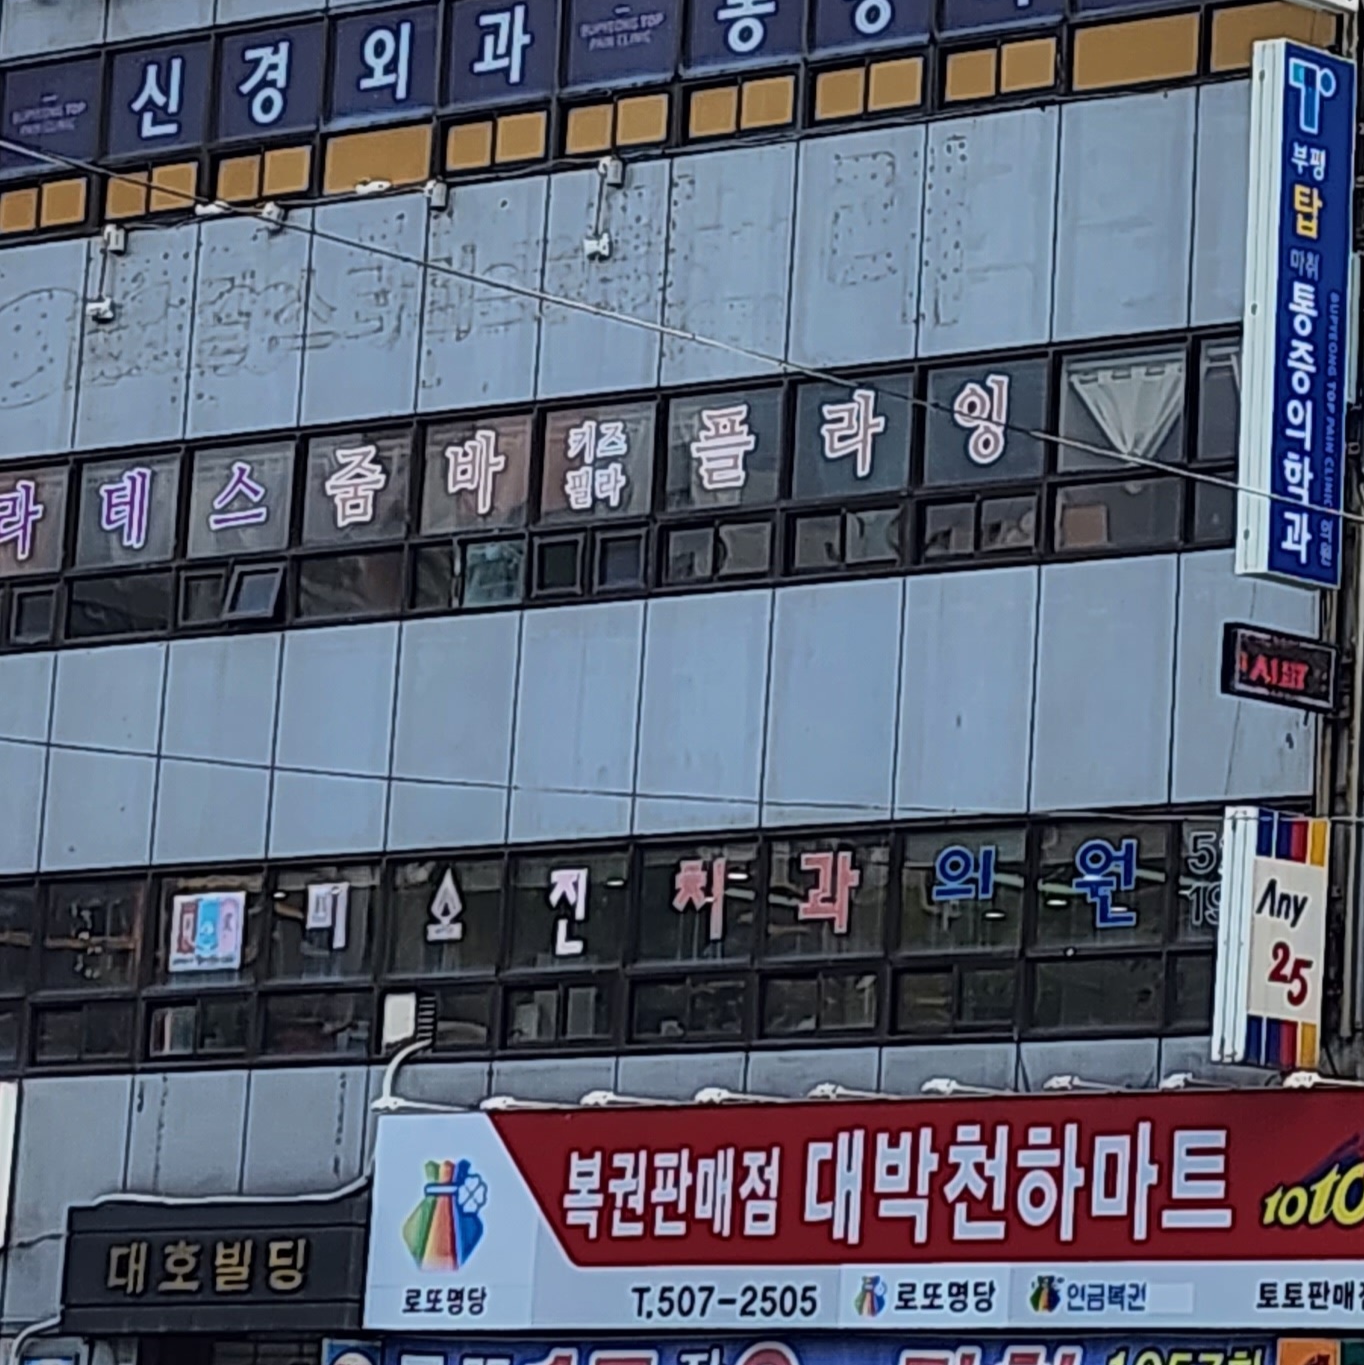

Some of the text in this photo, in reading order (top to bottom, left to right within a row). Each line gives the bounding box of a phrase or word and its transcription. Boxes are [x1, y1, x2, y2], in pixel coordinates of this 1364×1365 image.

[130, 3, 532, 139] 신경외과
[1294, 184, 1323, 239] 탑
[1279, 281, 1319, 565] 통증의학과
[1326, 381, 1337, 414] TOP
[567, 420, 627, 464] 키즈
[564, 462, 626, 509] 필라
[1255, 878, 1309, 928] Any
[1267, 941, 1313, 1006] 25
[563, 1120, 1233, 1244] 복권판매점 대박천하마트
[107, 1239, 310, 1296] 대호빌딩
[402, 1287, 488, 1317] 로또명당
[894, 1279, 996, 1313] 로또명당
